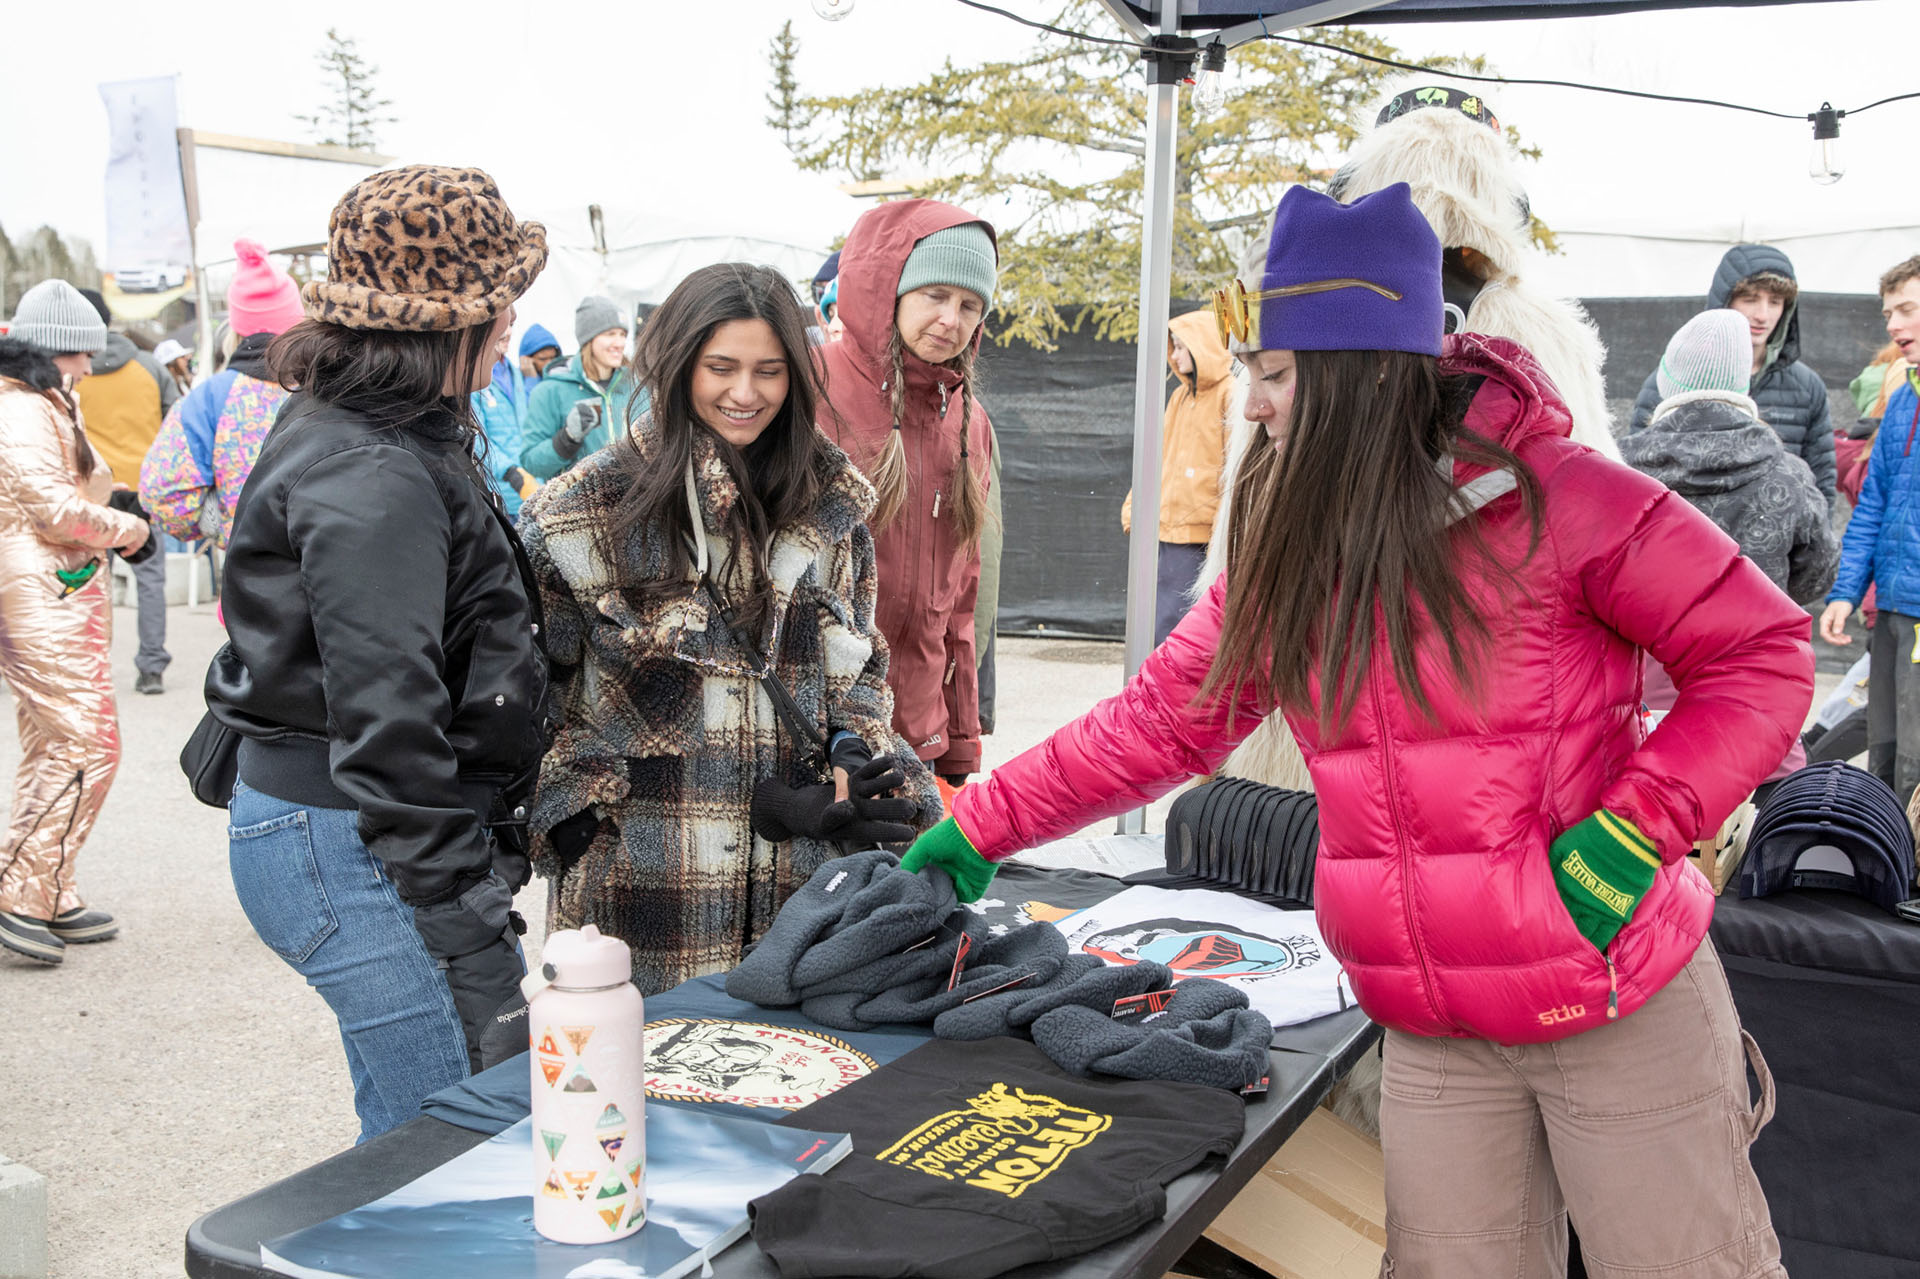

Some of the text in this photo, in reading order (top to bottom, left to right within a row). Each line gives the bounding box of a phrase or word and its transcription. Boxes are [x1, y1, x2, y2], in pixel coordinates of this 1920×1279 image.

[1565, 856, 1632, 912] NATURE VALLEY
[496, 1004, 530, 1023] Columbia
[1538, 1004, 1586, 1025] stio
[954, 1137, 1016, 1177] GRAVITY
[965, 1114, 1105, 1194] TETON
